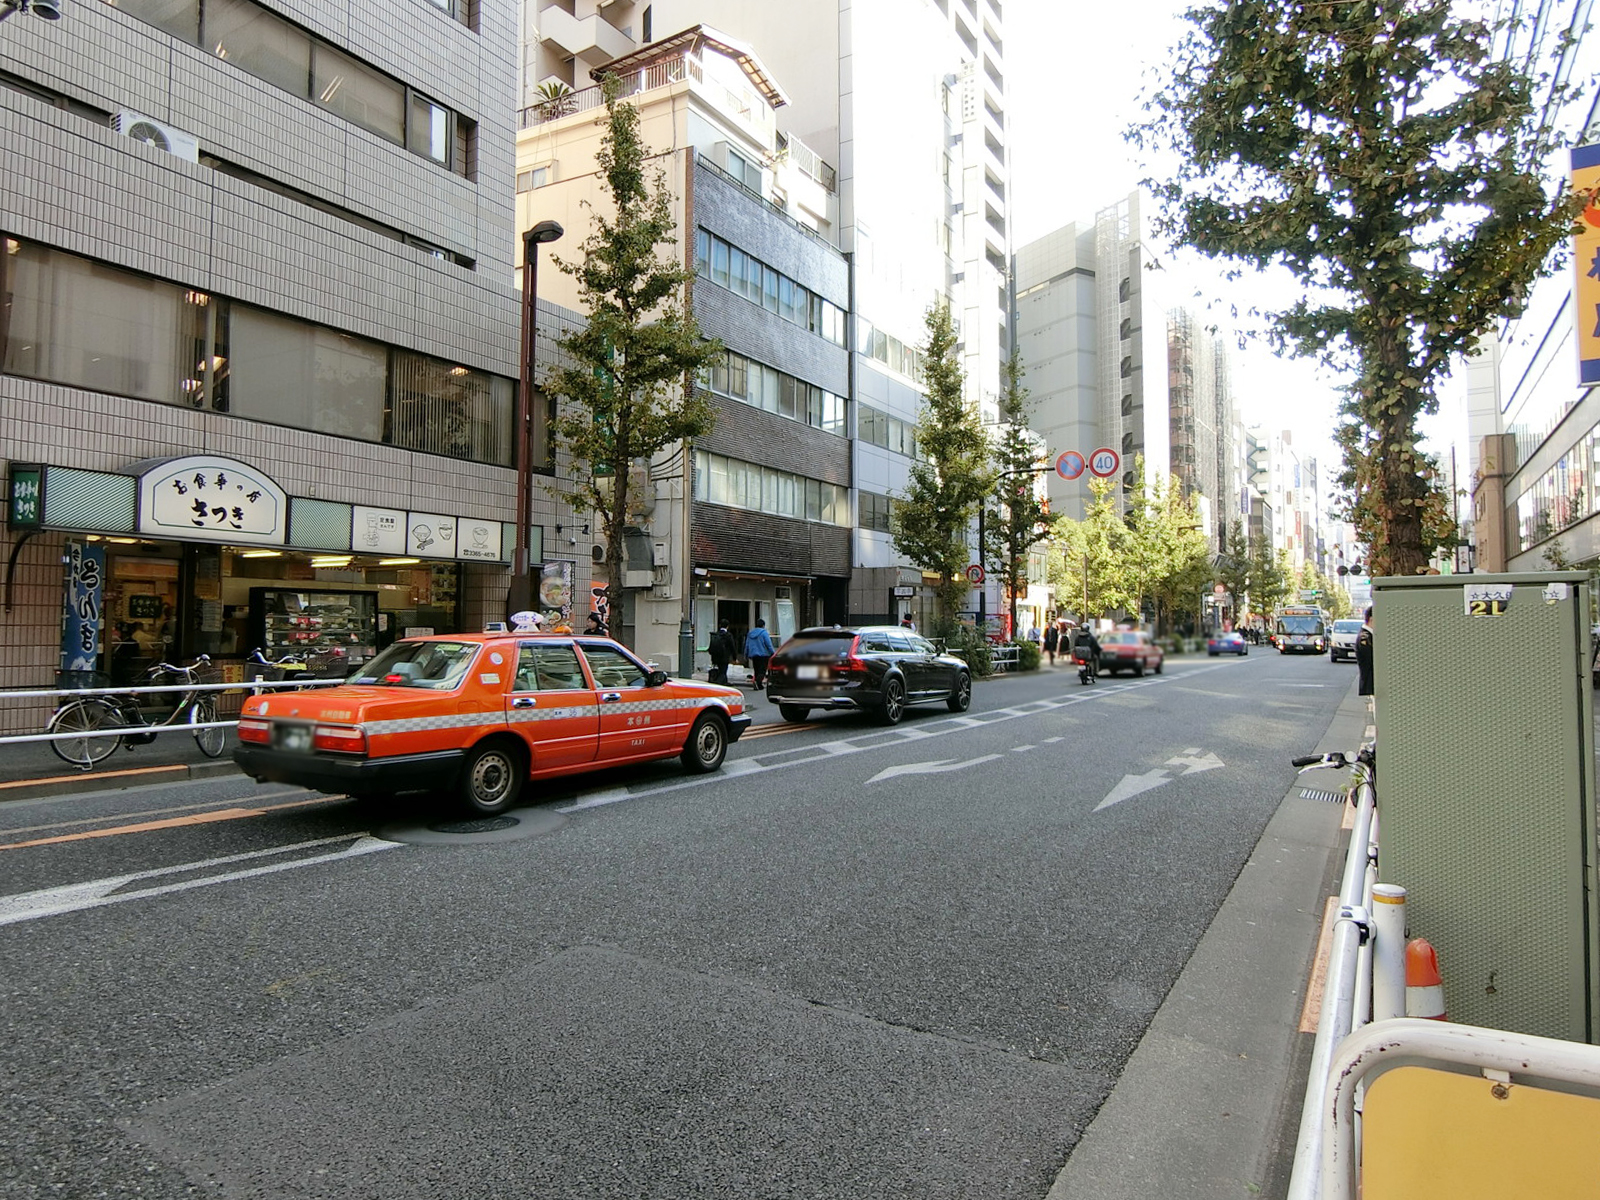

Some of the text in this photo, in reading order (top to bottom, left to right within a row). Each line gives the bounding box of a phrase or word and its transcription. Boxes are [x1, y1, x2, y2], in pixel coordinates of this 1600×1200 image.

[1096, 456, 1112, 469] 40
[172, 472, 262, 503] お食事の店
[191, 498, 244, 529] さつき
